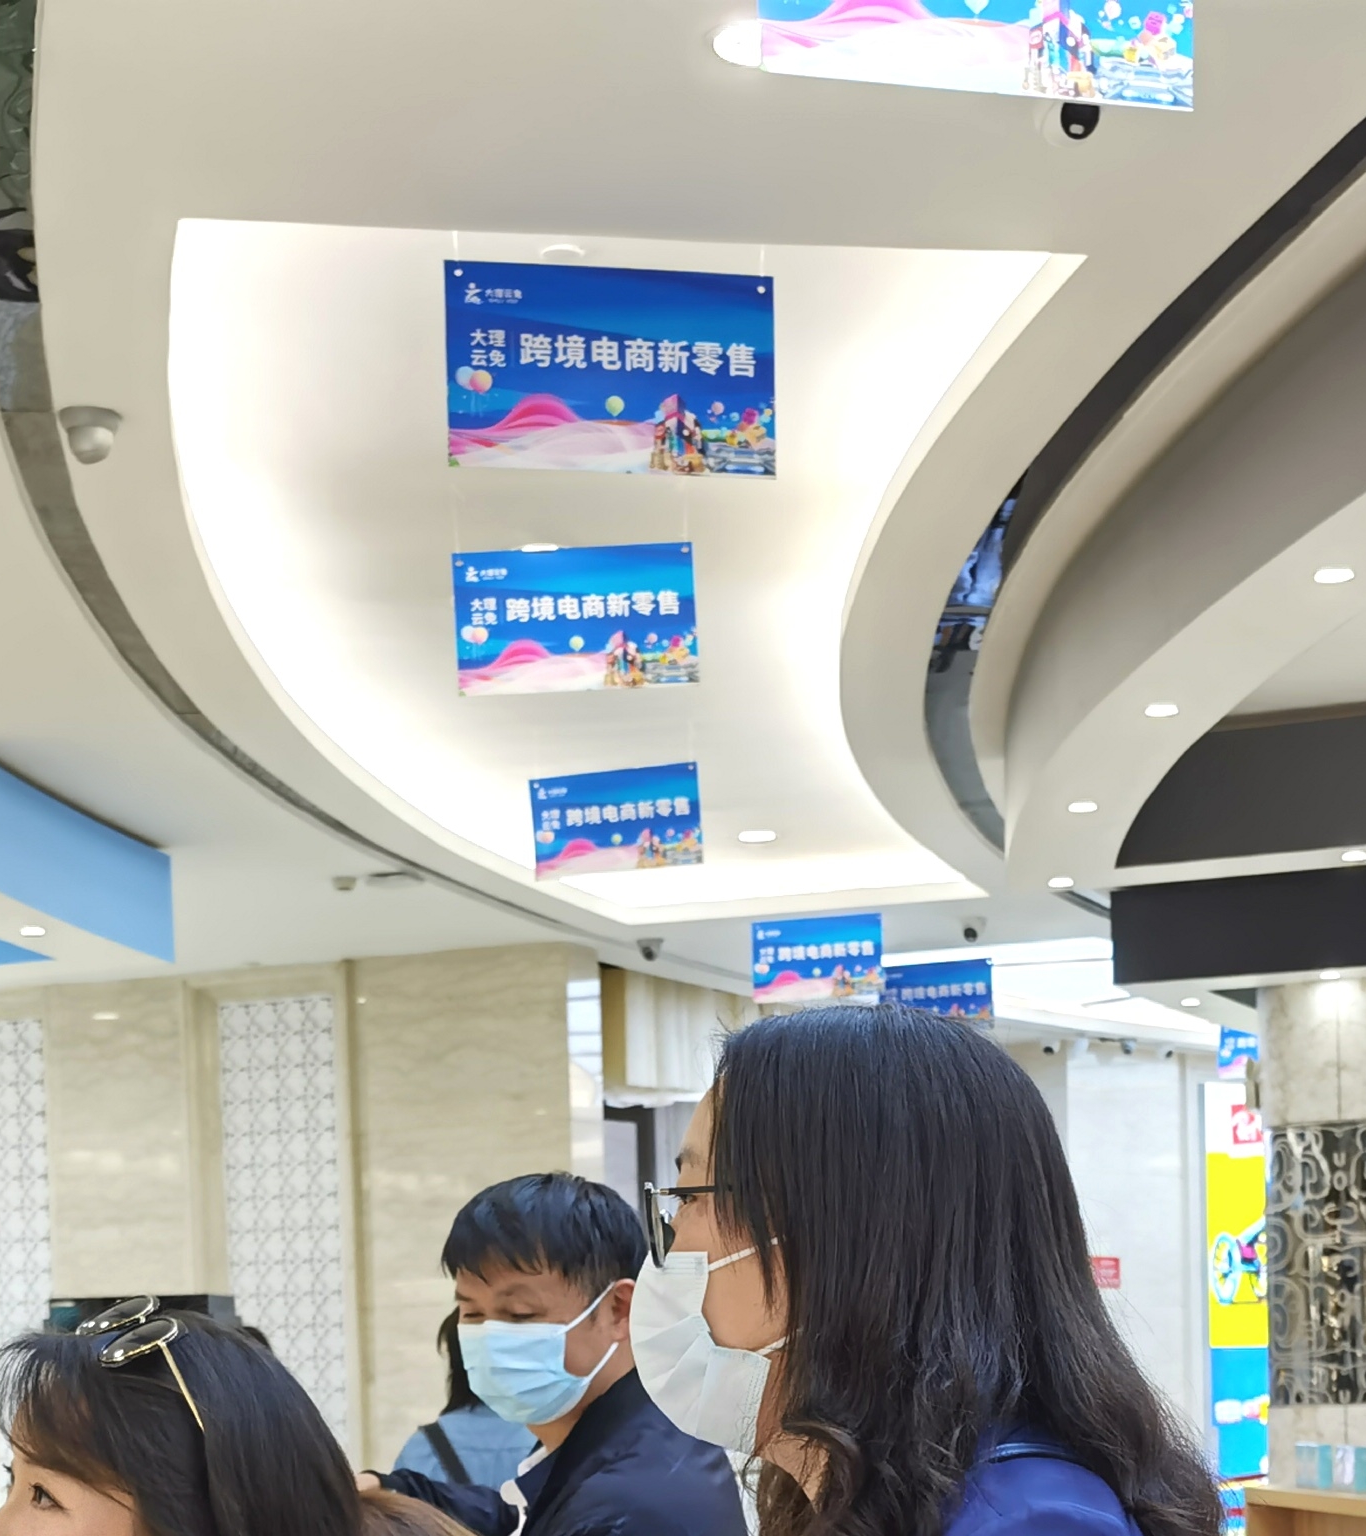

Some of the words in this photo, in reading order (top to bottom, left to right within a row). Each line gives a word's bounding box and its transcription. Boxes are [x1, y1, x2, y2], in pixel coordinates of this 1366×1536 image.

[469, 328, 507, 348] 大理
[469, 349, 508, 368] 云免
[519, 332, 757, 378] 跨境电商新零售
[504, 589, 681, 623] 跨境电商新零售
